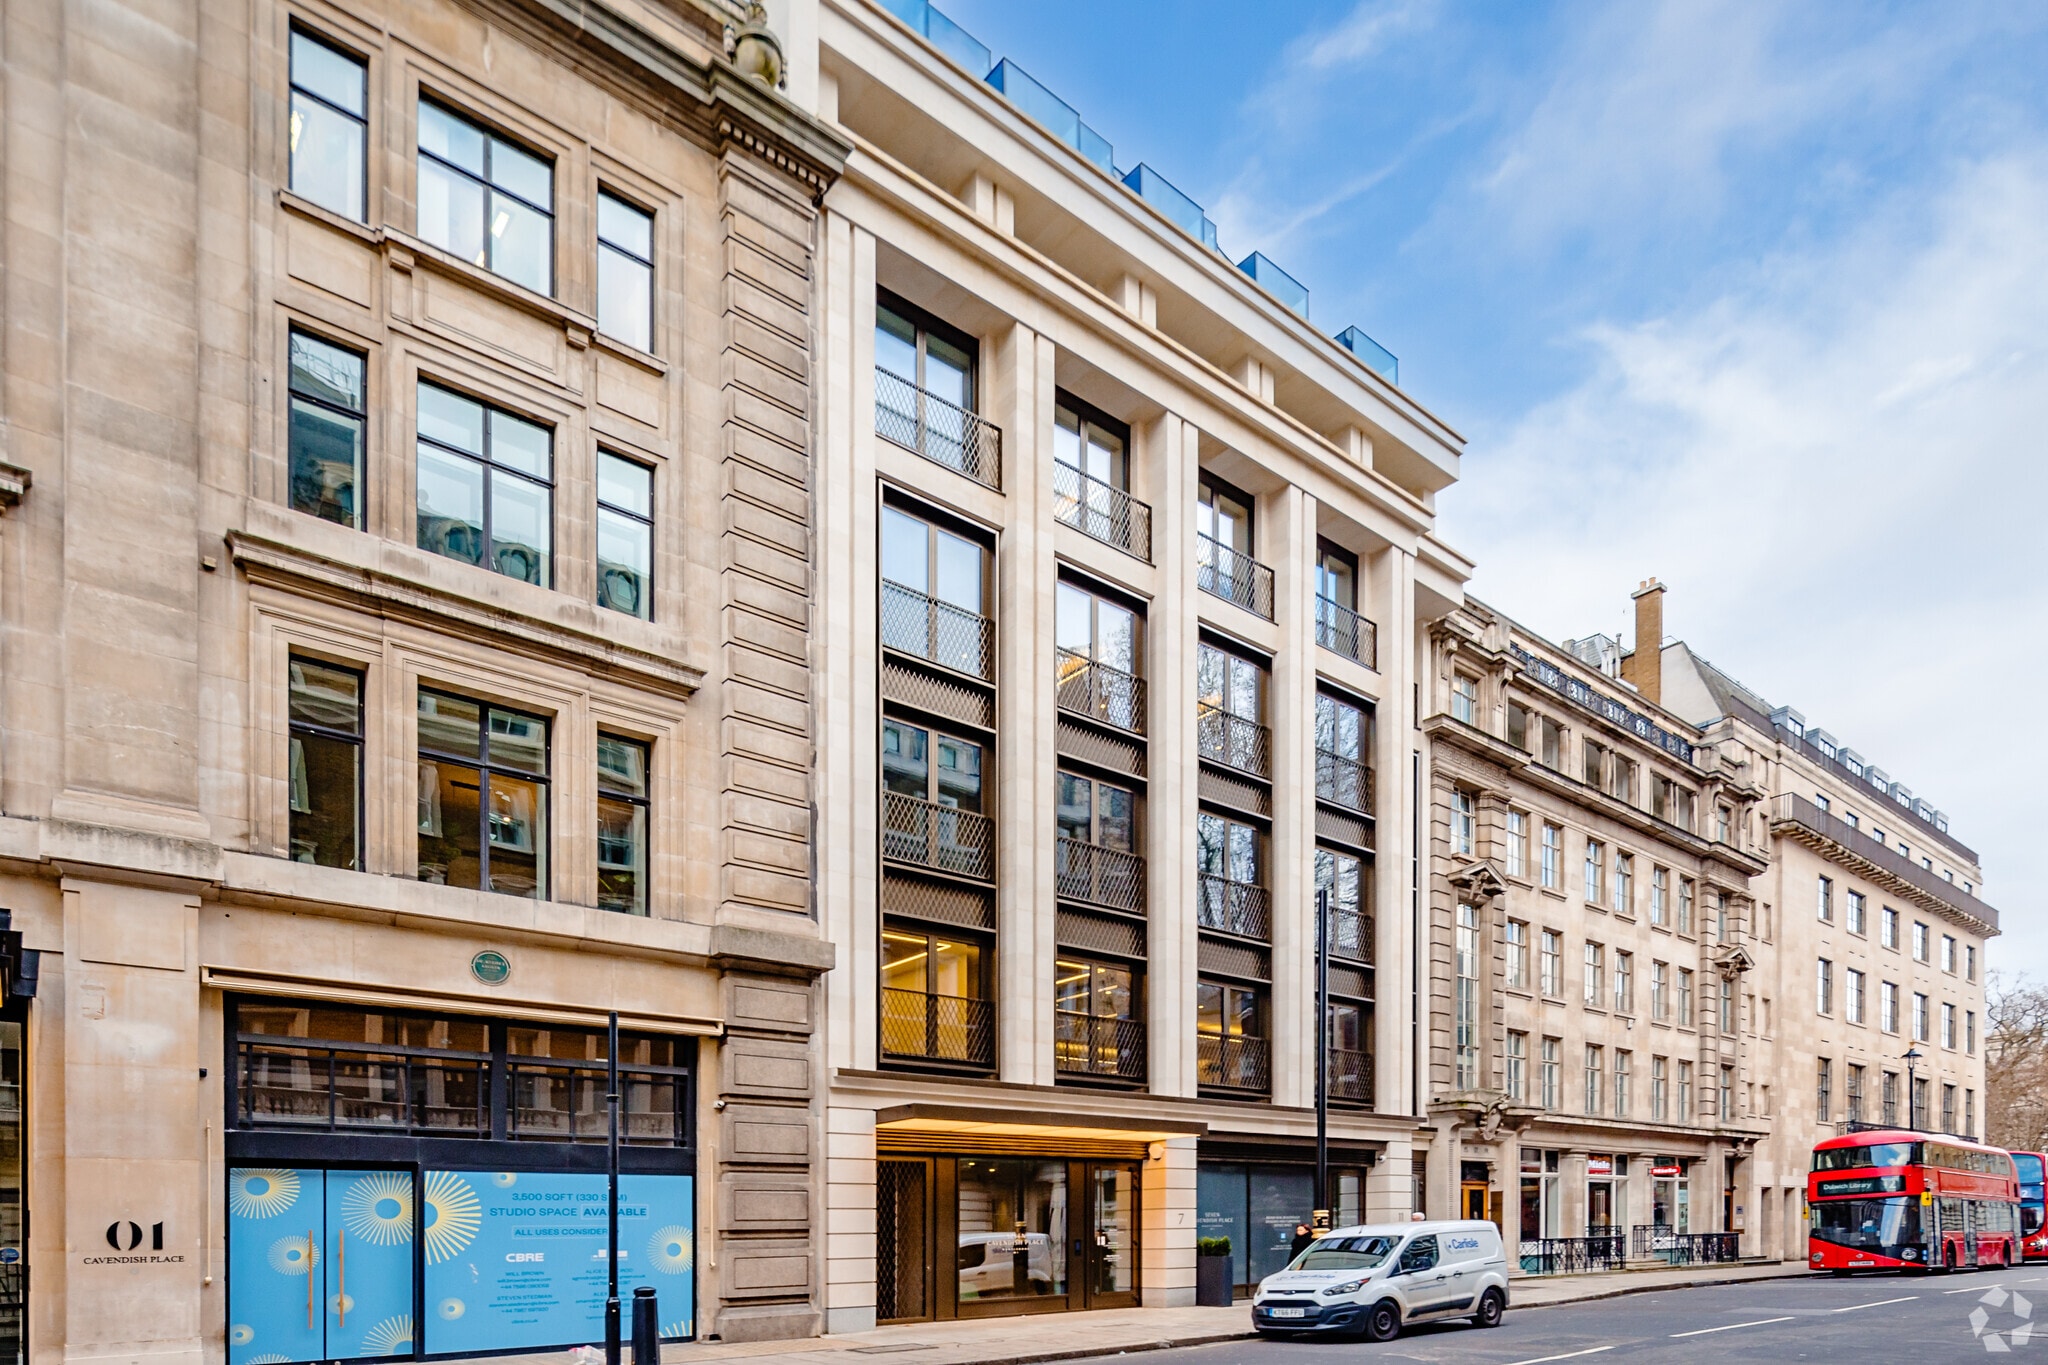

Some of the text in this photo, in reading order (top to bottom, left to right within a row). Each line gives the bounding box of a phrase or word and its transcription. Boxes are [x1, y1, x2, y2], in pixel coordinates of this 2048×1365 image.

[1588, 1160, 1611, 1169] Miele
[512, 1193, 628, 1202] 3,500 SQFT (330 SM)
[489, 1207, 647, 1217] STUDIO SPACE AVAABLE
[1178, 1213, 1185, 1224] 7
[535, 1228, 559, 1236] USES
[561, 1227, 619, 1236] CONSIDER
[1451, 1238, 1479, 1250] Carlisle
[83, 1255, 185, 1265] CAVENDISH PLACE
[505, 1252, 545, 1263] CBRE
